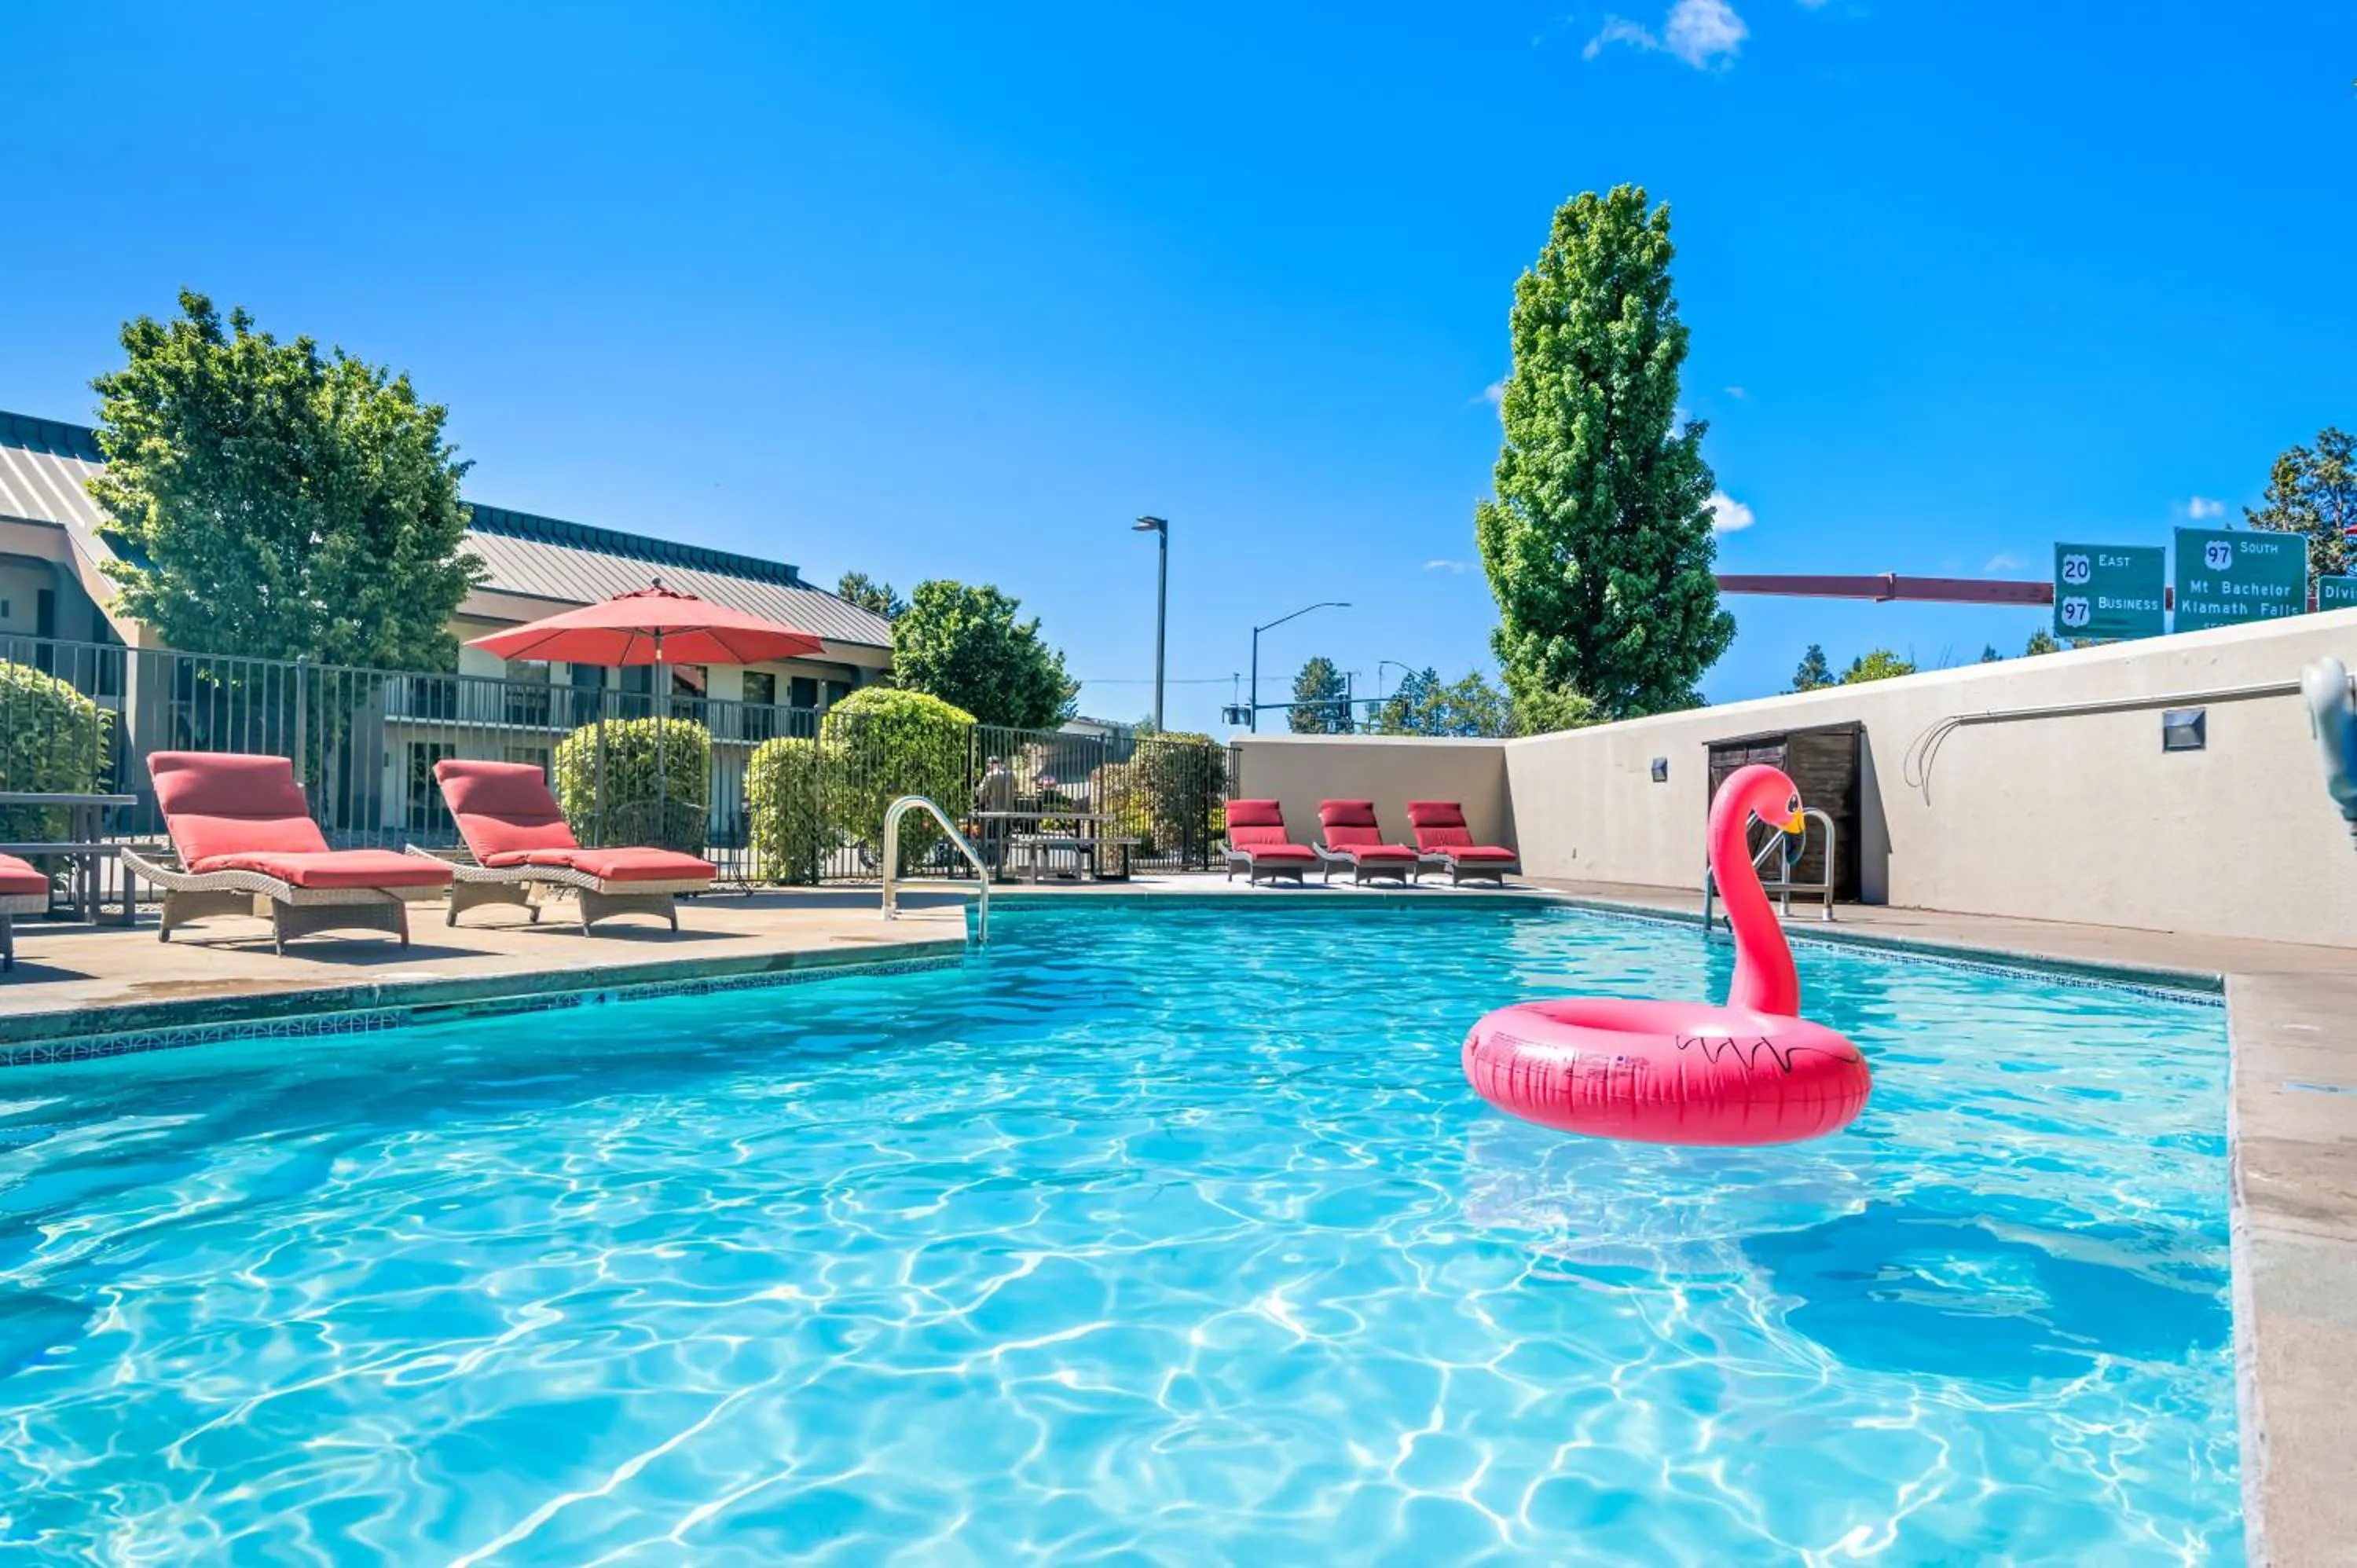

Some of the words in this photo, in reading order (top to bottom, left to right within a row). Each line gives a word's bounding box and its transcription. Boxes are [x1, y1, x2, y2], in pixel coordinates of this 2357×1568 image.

[2208, 546, 2229, 562] 97
[2240, 542, 2278, 554] SOUTH
[2065, 560, 2088, 577] 20
[2099, 554, 2131, 566] EAST
[2190, 581, 2209, 593] Mt
[2222, 581, 2291, 596] Bachelor
[2325, 585, 2357, 599] Divi
[2065, 603, 2087, 621] 97
[2099, 596, 2158, 610] BUSINESS
[2182, 600, 2248, 614] Klamath
